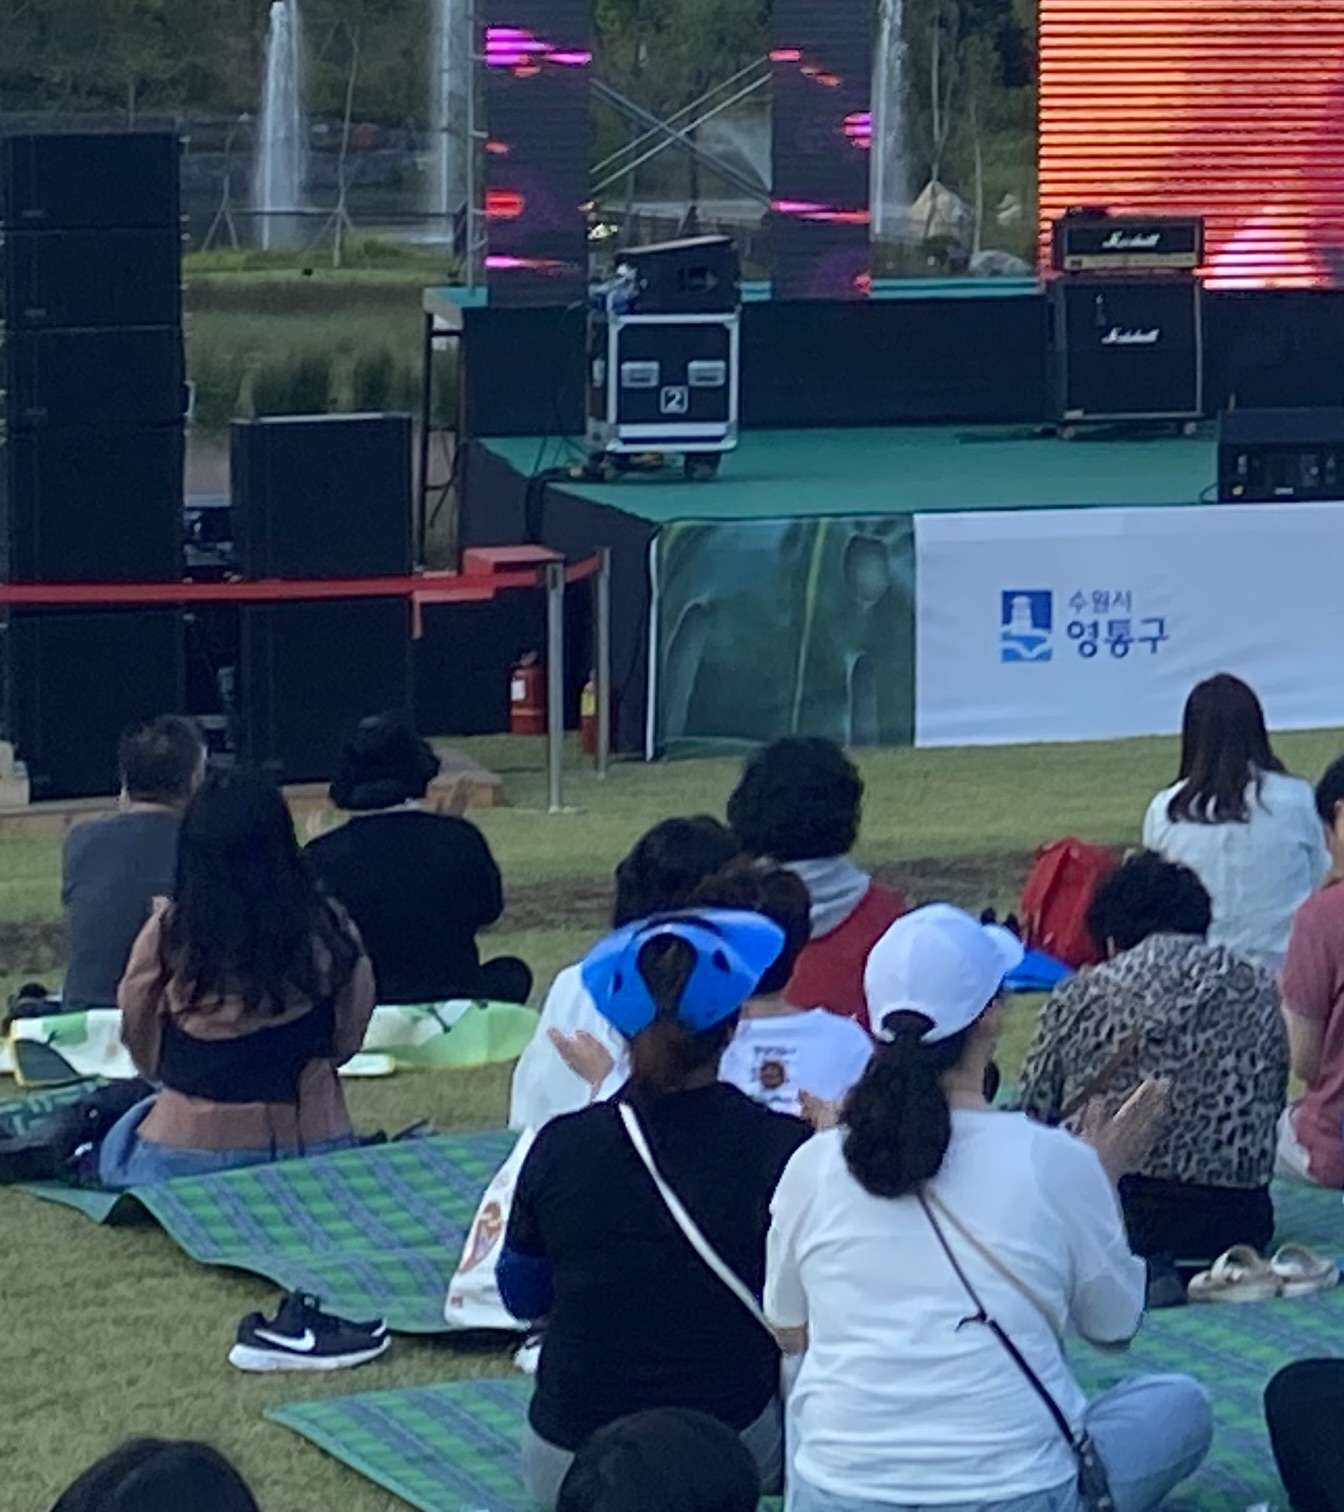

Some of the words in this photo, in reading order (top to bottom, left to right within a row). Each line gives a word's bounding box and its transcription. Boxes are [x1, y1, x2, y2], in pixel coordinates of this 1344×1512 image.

[666, 390, 683, 409] 2
[1068, 590, 1132, 615] 수원시
[1066, 617, 1171, 659] 영통구
